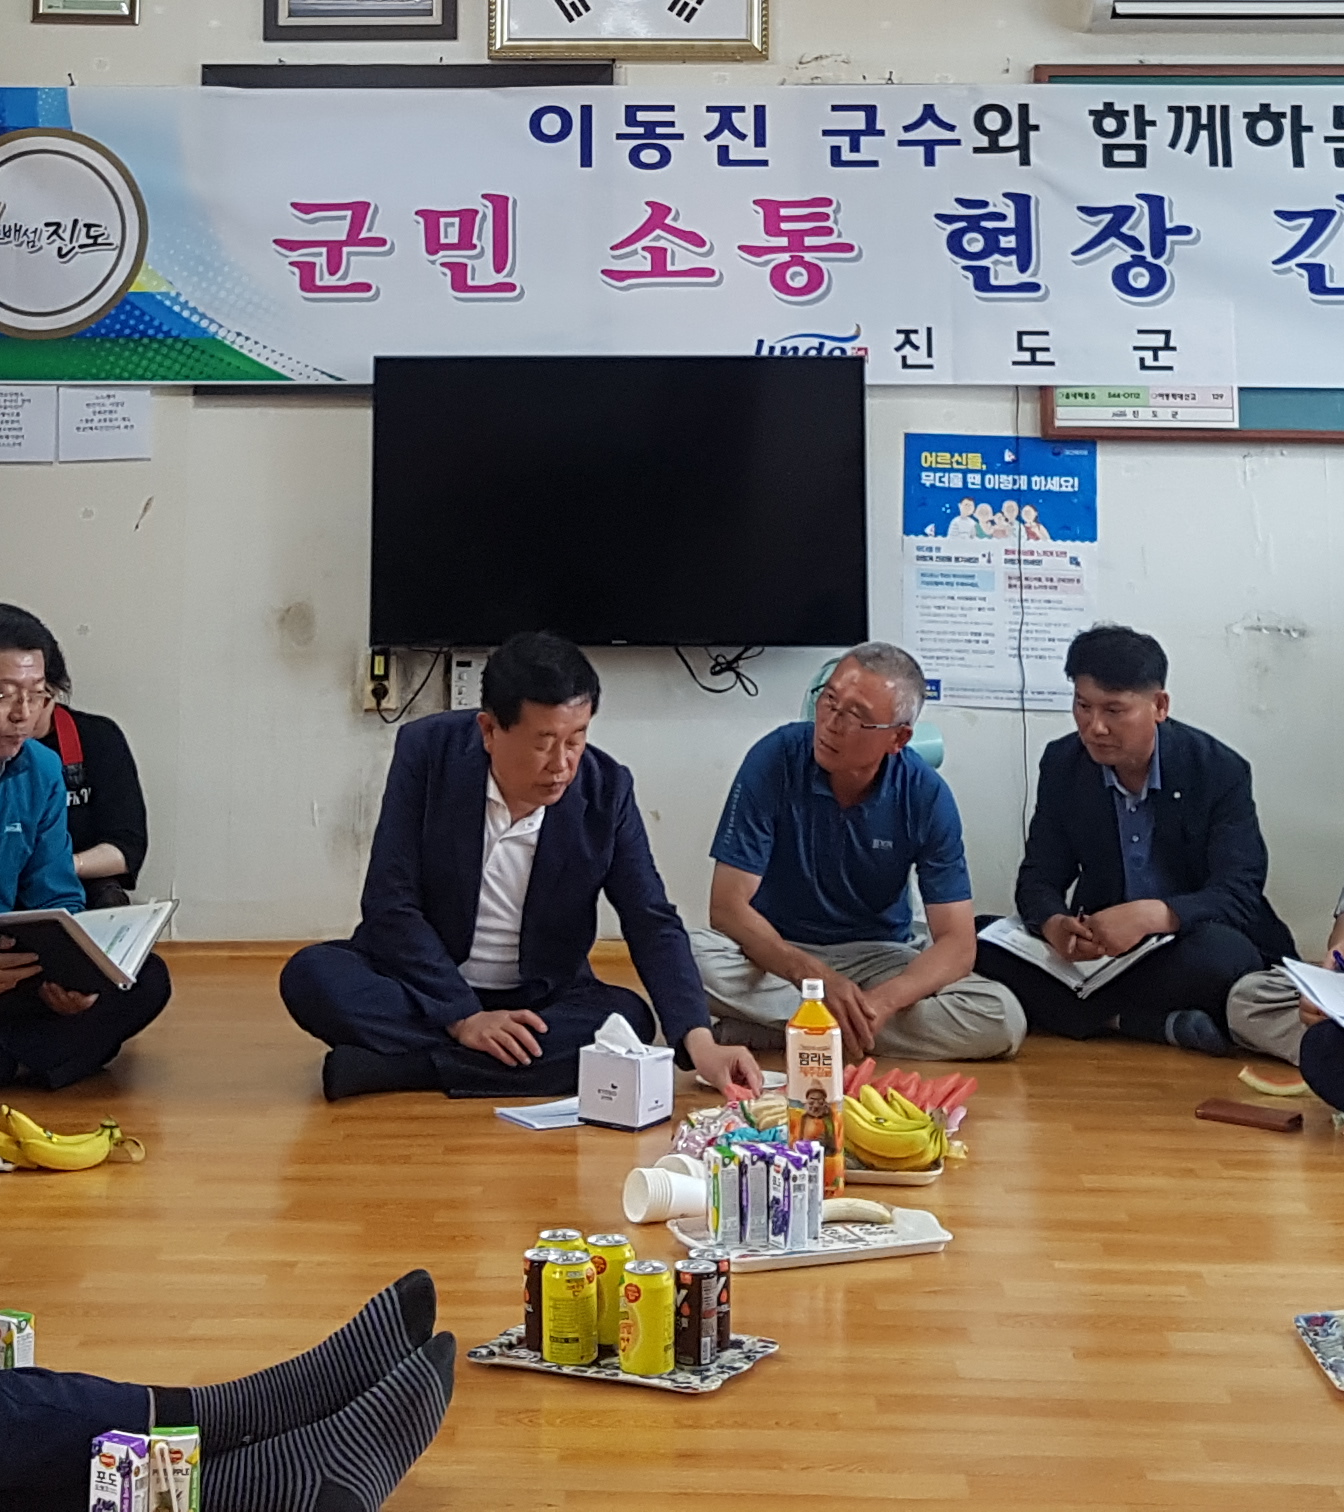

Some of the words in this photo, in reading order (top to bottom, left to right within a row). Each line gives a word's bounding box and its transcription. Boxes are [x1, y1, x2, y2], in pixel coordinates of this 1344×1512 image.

[529, 104, 769, 171] 이동진
[821, 103, 1041, 169] 군수와
[43, 218, 115, 260] 진도
[272, 193, 517, 294] 군민
[600, 197, 856, 297] 소통
[933, 192, 1193, 298] 현장
[920, 451, 987, 471] 어르신들,
[920, 471, 964, 489] 무더울
[966, 472, 982, 489] 땐
[984, 473, 1028, 491] 이렇게
[1031, 475, 1079, 492] 하세요!
[95, 1470, 118, 1487] 포도
